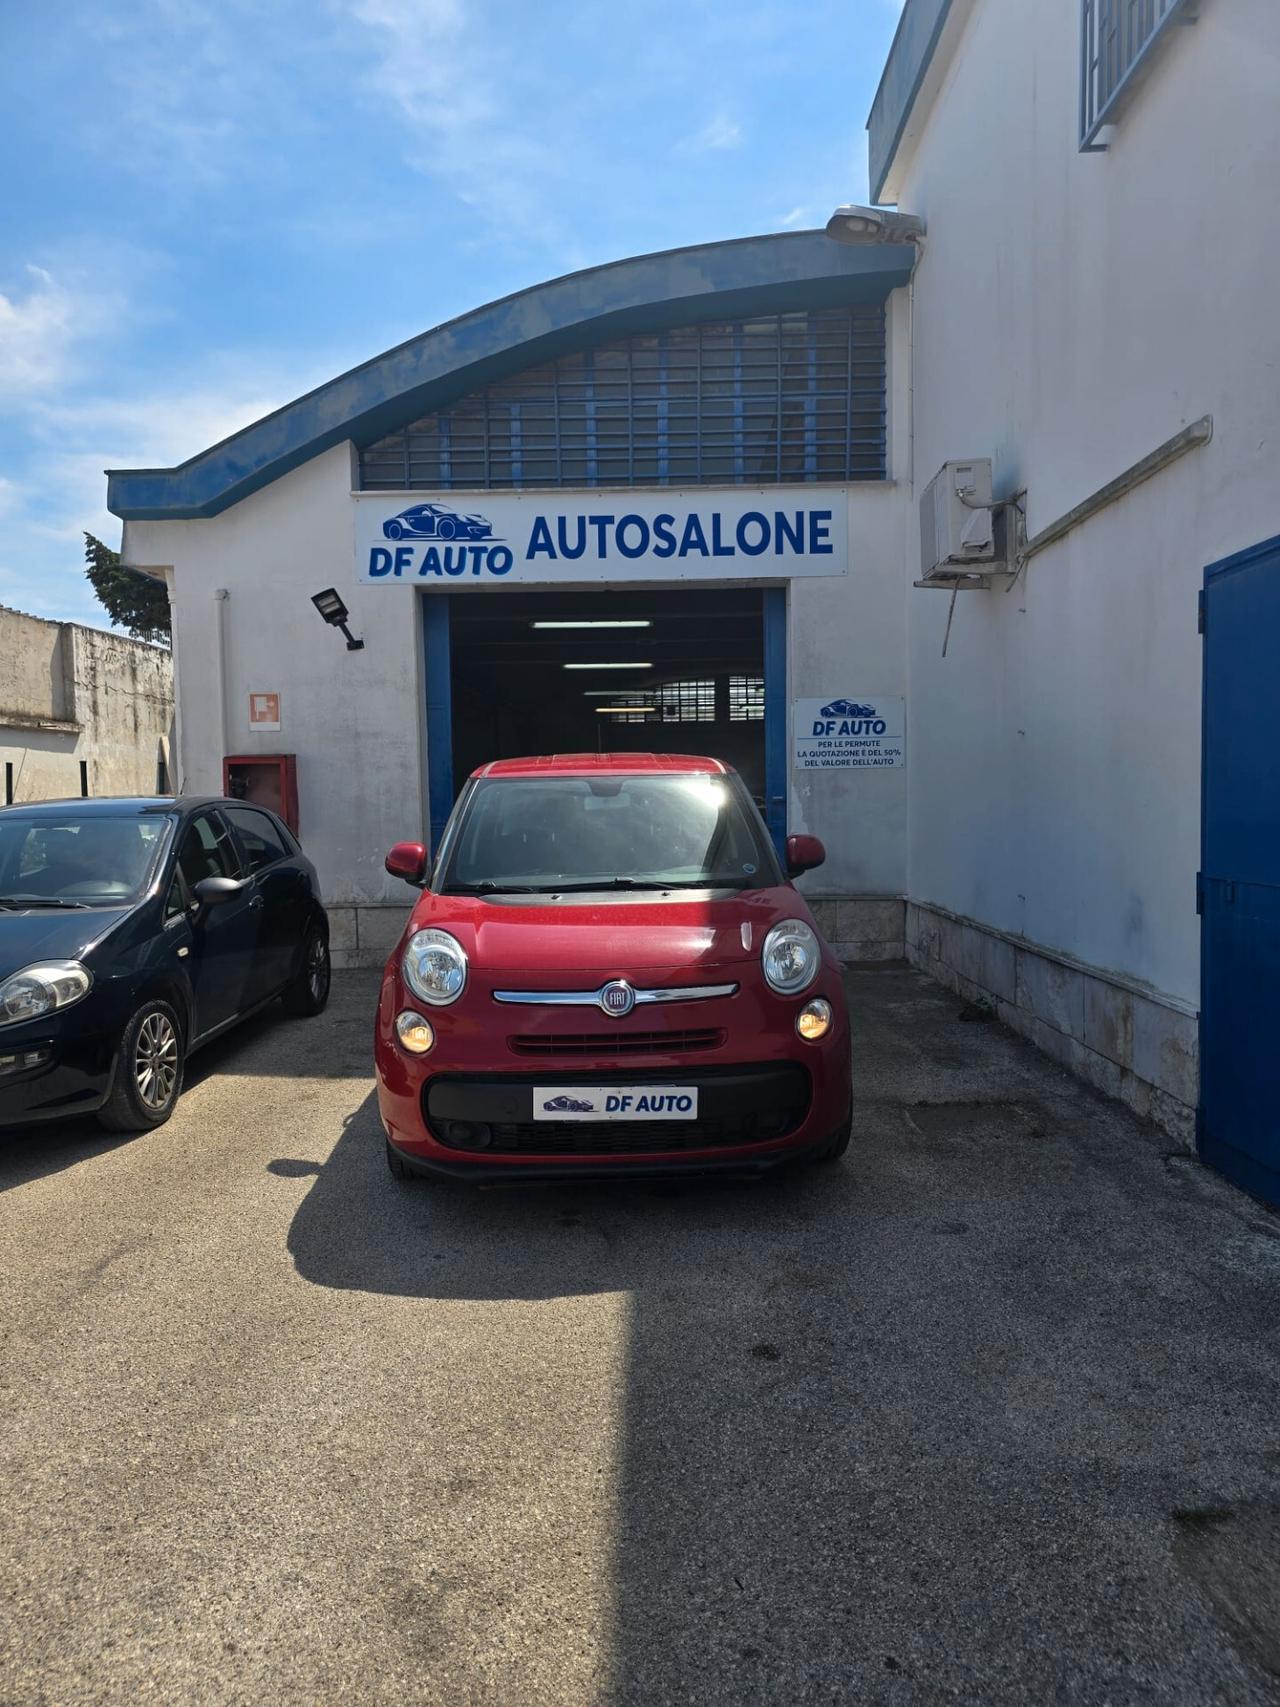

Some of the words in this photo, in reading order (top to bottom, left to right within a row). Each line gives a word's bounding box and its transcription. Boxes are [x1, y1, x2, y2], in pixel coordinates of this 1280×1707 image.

[525, 510, 834, 560] AUTOSALONE
[368, 547, 413, 577] DF
[418, 545, 514, 576] AUTO
[812, 721, 836, 736] DF
[838, 720, 887, 736] AUTO
[845, 740, 881, 748] PERMUTE
[809, 749, 860, 758] QUOTAZIONE
[868, 749, 882, 757] DEL
[884, 748, 902, 756] 50%
[804, 759, 820, 767] DEL
[821, 759, 851, 767] VALORE
[852, 758, 895, 766] DELL'AUTO
[609, 992, 626, 1006] FIAT
[605, 1096, 634, 1113] DF
[635, 1095, 693, 1113] AUTO
